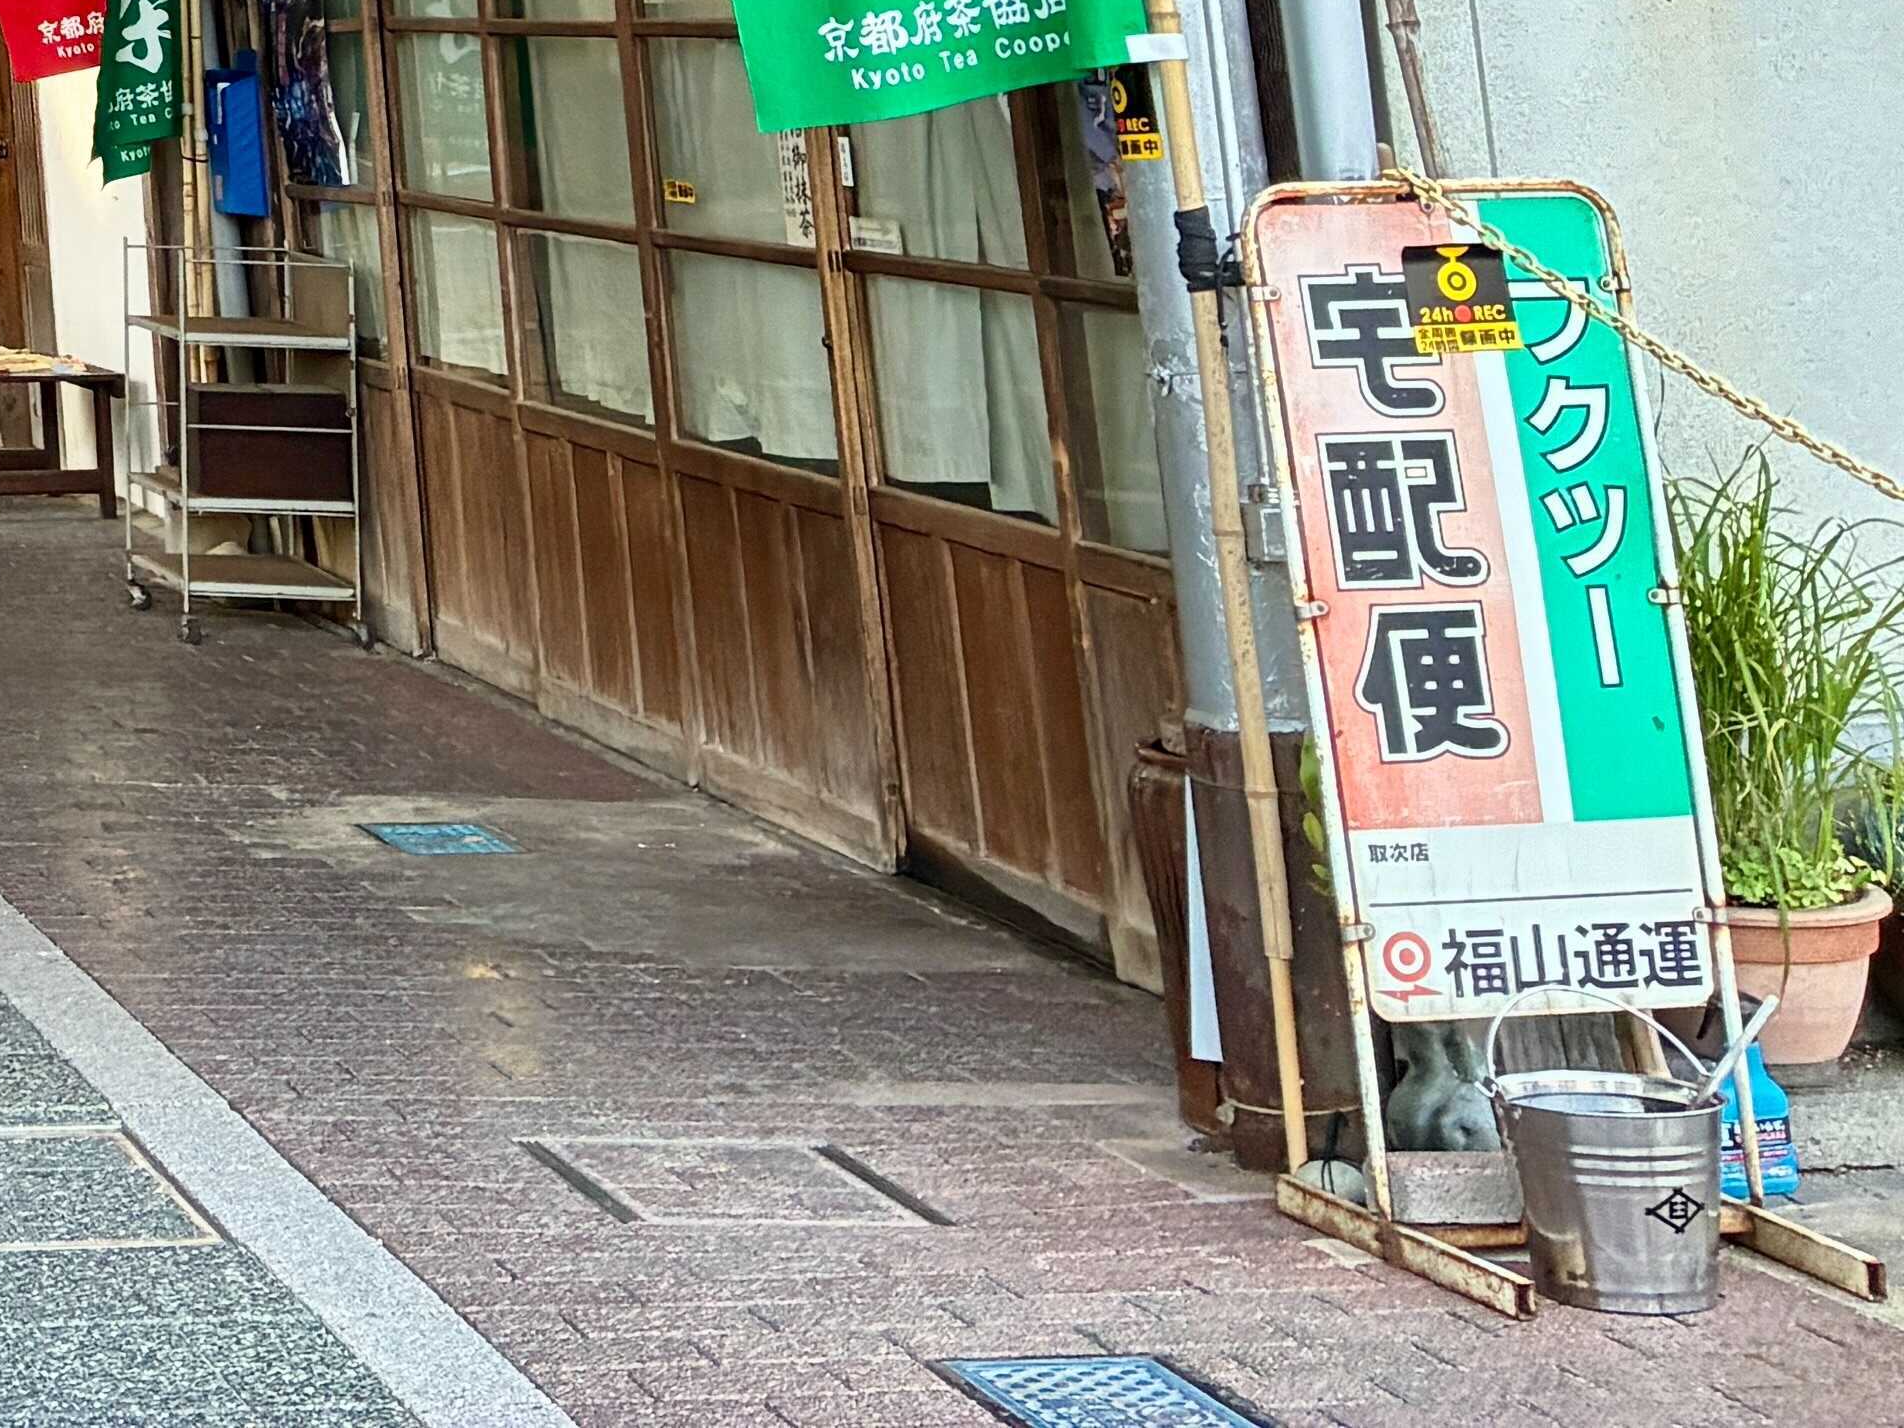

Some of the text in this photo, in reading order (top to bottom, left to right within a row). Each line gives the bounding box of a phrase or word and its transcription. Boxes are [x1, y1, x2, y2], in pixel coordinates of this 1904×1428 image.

[56, 42, 95, 58] Kyoto
[851, 59, 926, 93] Kyoto
[939, 46, 979, 74] Tea
[1419, 305, 1506, 324] 24h REC
[1298, 262, 1510, 764] 宅配便
[1367, 843, 1430, 864] 取次店
[1441, 919, 1704, 999] 福山通運
